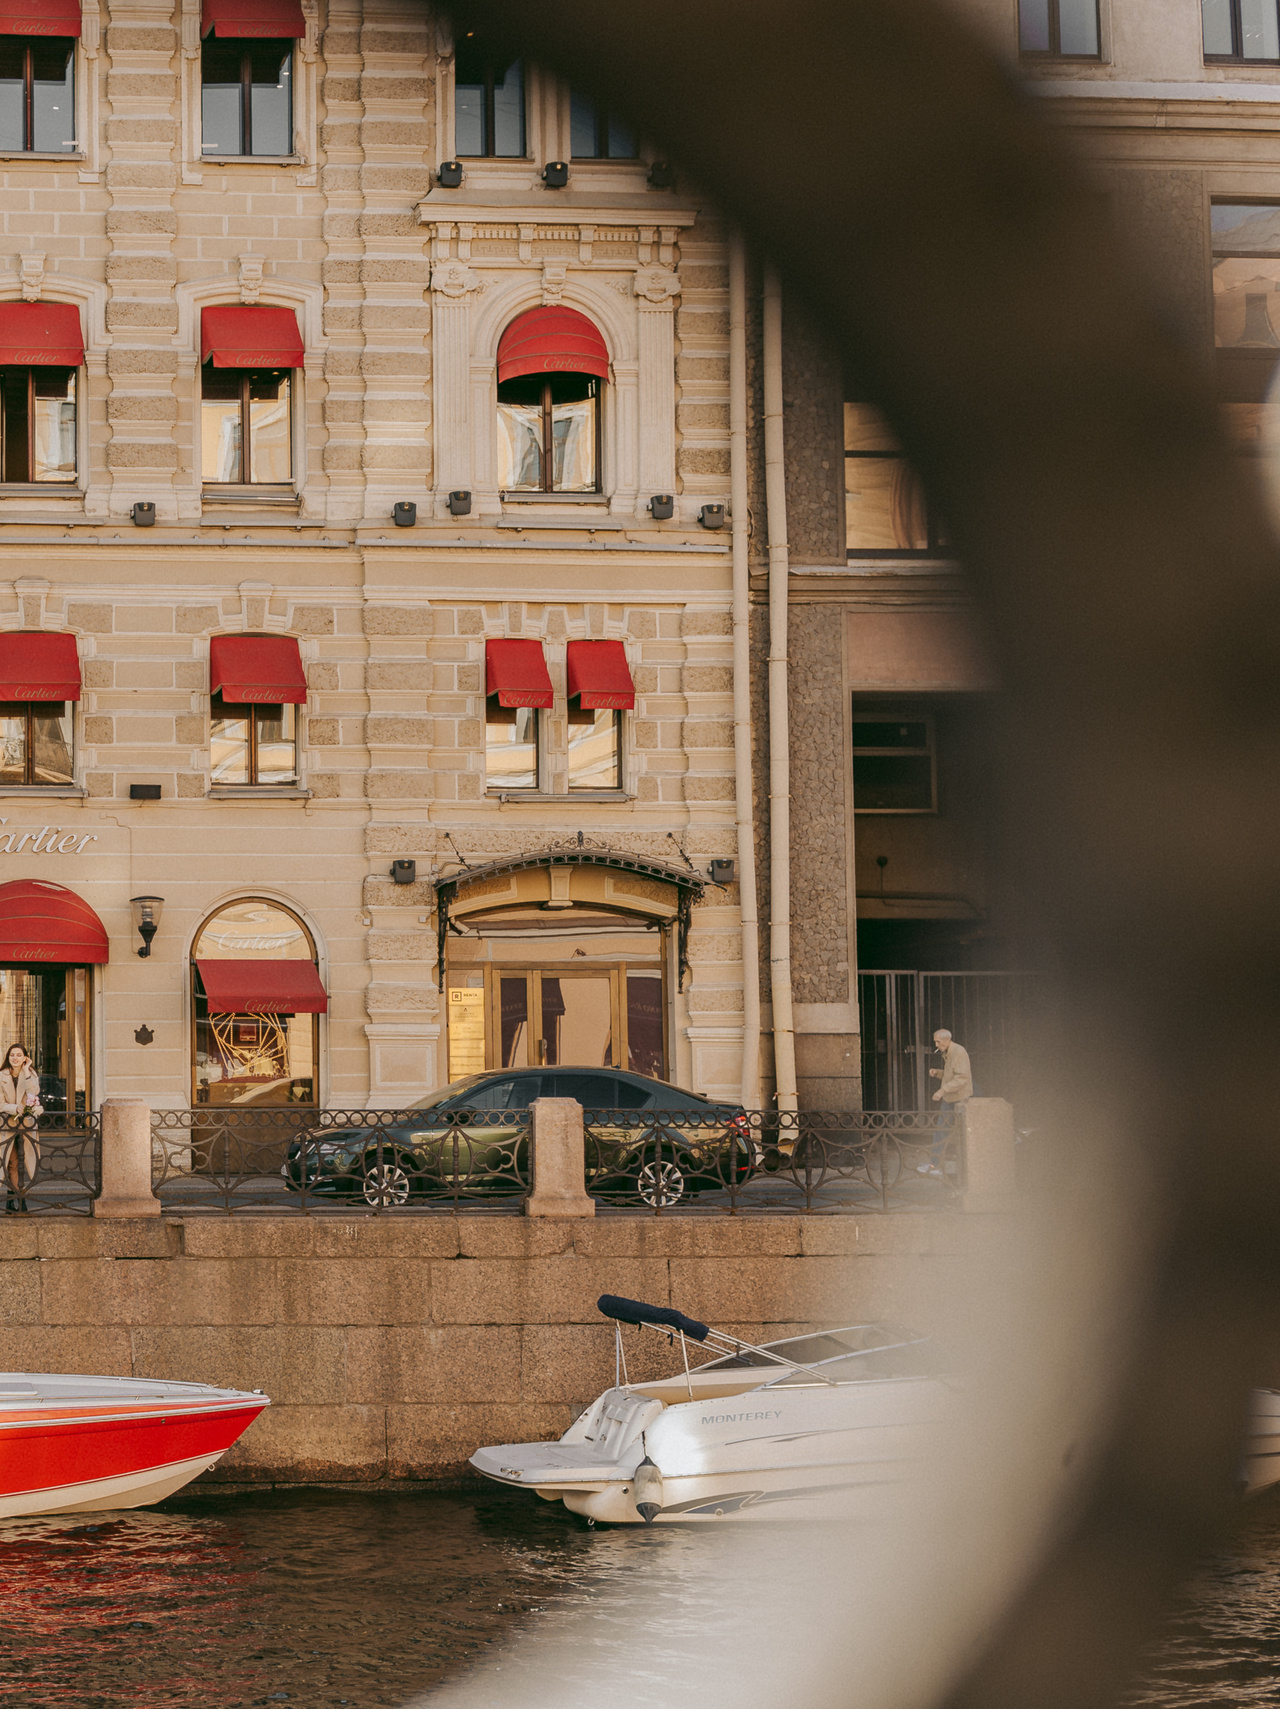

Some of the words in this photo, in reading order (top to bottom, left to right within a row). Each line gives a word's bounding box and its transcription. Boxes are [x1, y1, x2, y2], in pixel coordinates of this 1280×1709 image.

[12, 19, 58, 33] Cartier
[14, 350, 59, 363] Cartier
[236, 353, 281, 366] Cartier
[543, 356, 587, 369] Cartier
[14, 686, 61, 699] Cartier
[241, 687, 287, 700] Cartier
[503, 692, 549, 706] Cartier
[584, 693, 631, 707] Cartier
[217, 929, 287, 951] Cartier
[12, 945, 59, 959] Cartier
[244, 999, 291, 1012] Cartier
[701, 1410, 782, 1425] MONTEREY
